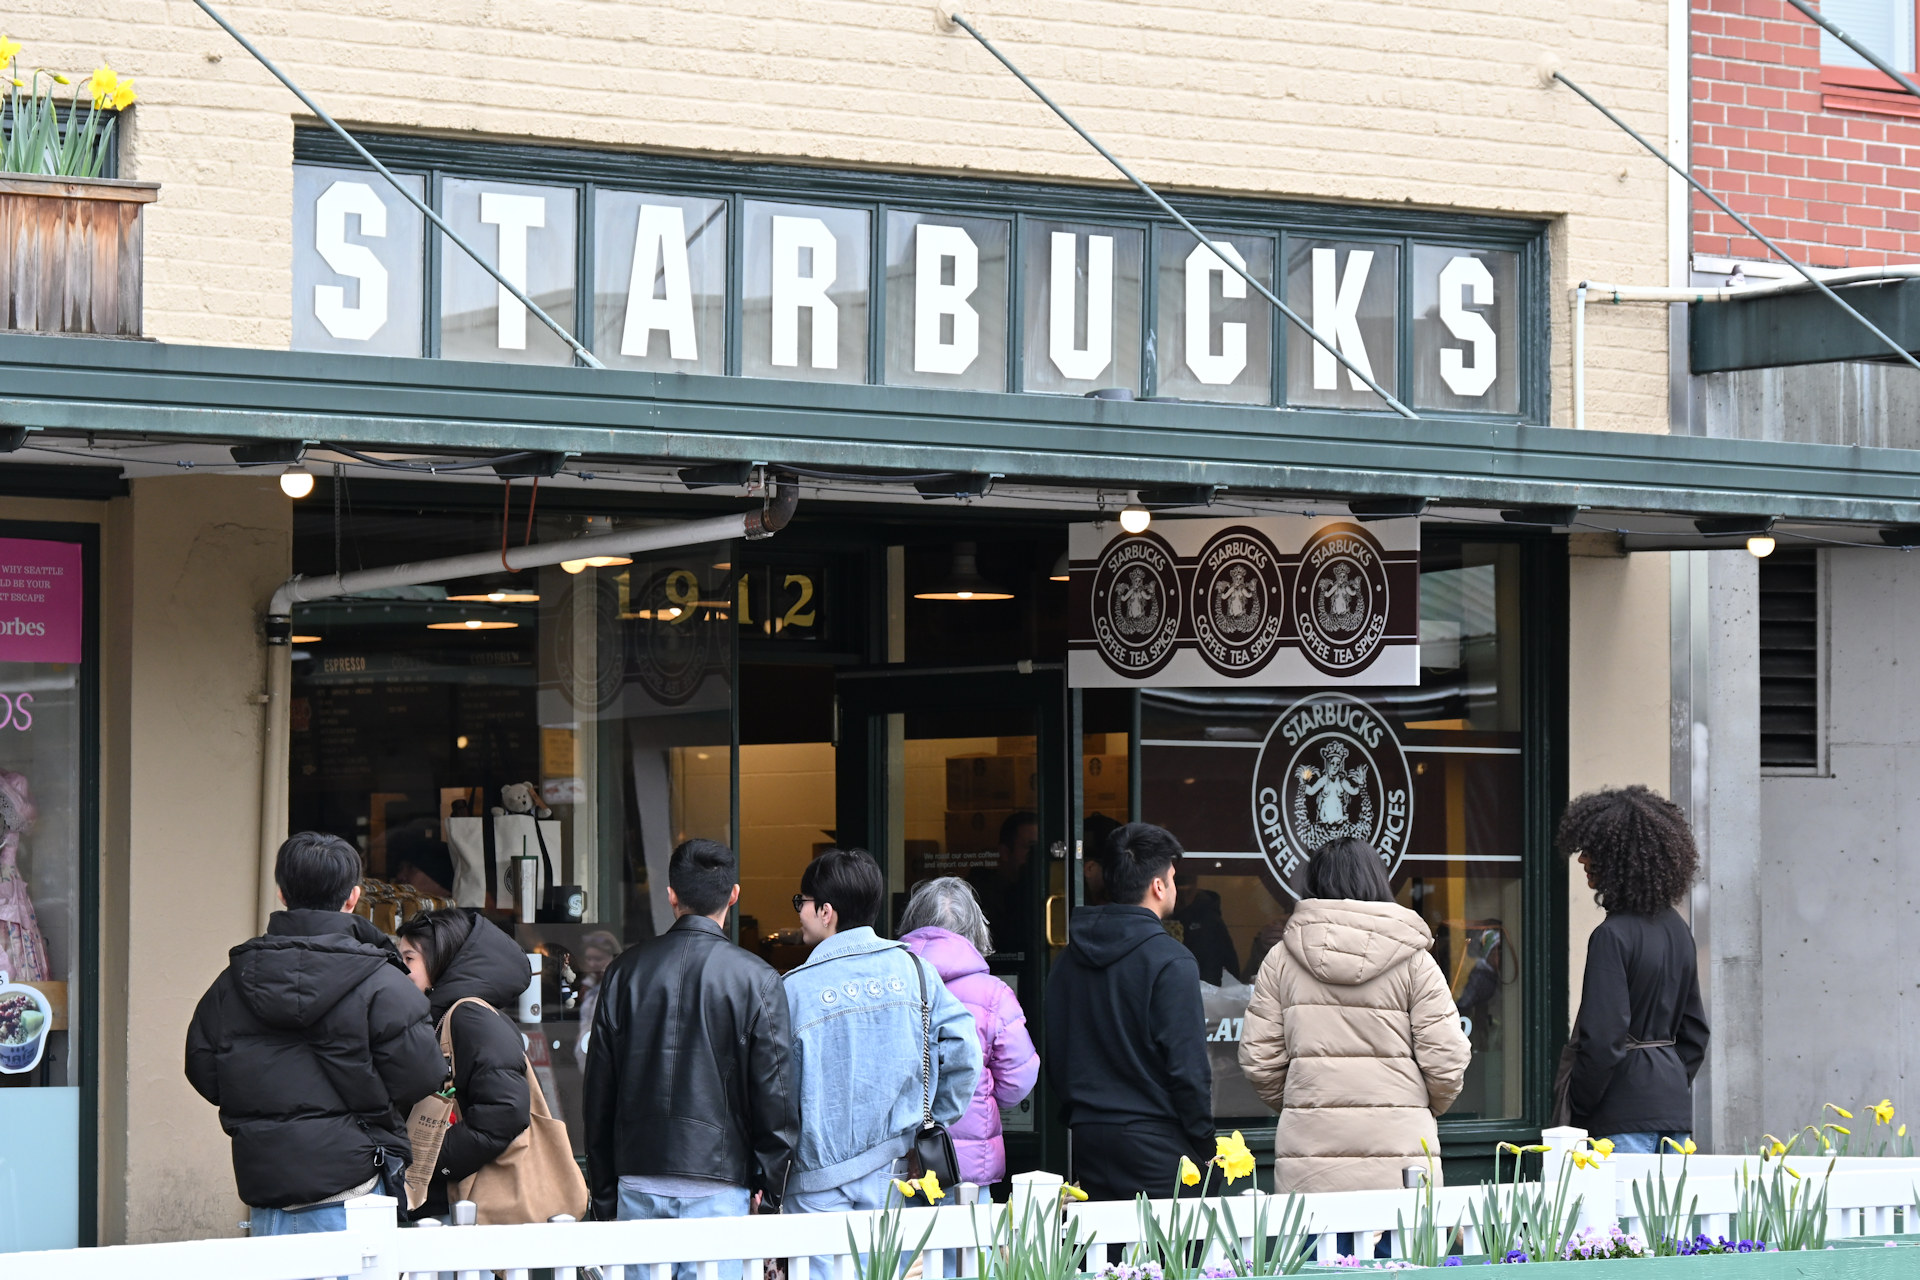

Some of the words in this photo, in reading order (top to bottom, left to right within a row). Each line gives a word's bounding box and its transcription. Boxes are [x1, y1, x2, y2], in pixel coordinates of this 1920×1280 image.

[314, 181, 1497, 397] STARBUCKS
[1108, 545, 1166, 573] STARBUCKS
[1208, 542, 1267, 570] STARBUCKS
[1311, 539, 1372, 568] STARBUCKS
[1, 565, 22, 574] WHY
[24, 566, 64, 576] SEATTLE
[13, 579, 25, 588] BE
[26, 580, 51, 589] YOUR
[11, 593, 45, 602] ESCAPE
[1098, 617, 1126, 661] COFFEE
[1129, 651, 1149, 665] TEA
[1149, 617, 1177, 659] SPICES
[1197, 615, 1226, 660] COFFEE
[1230, 650, 1250, 664] TEA
[1250, 615, 1278, 658] SPICES
[1300, 613, 1330, 659] COFFEE
[1334, 648, 1354, 663] TEA
[1355, 613, 1383, 657] SPICES
[324, 657, 366, 672] ESPRESSO
[1283, 702, 1384, 748] STARBUCKS
[1259, 787, 1300, 879] COFFEE
[1377, 789, 1406, 867] SPICES
[937, 861, 956, 869] import
